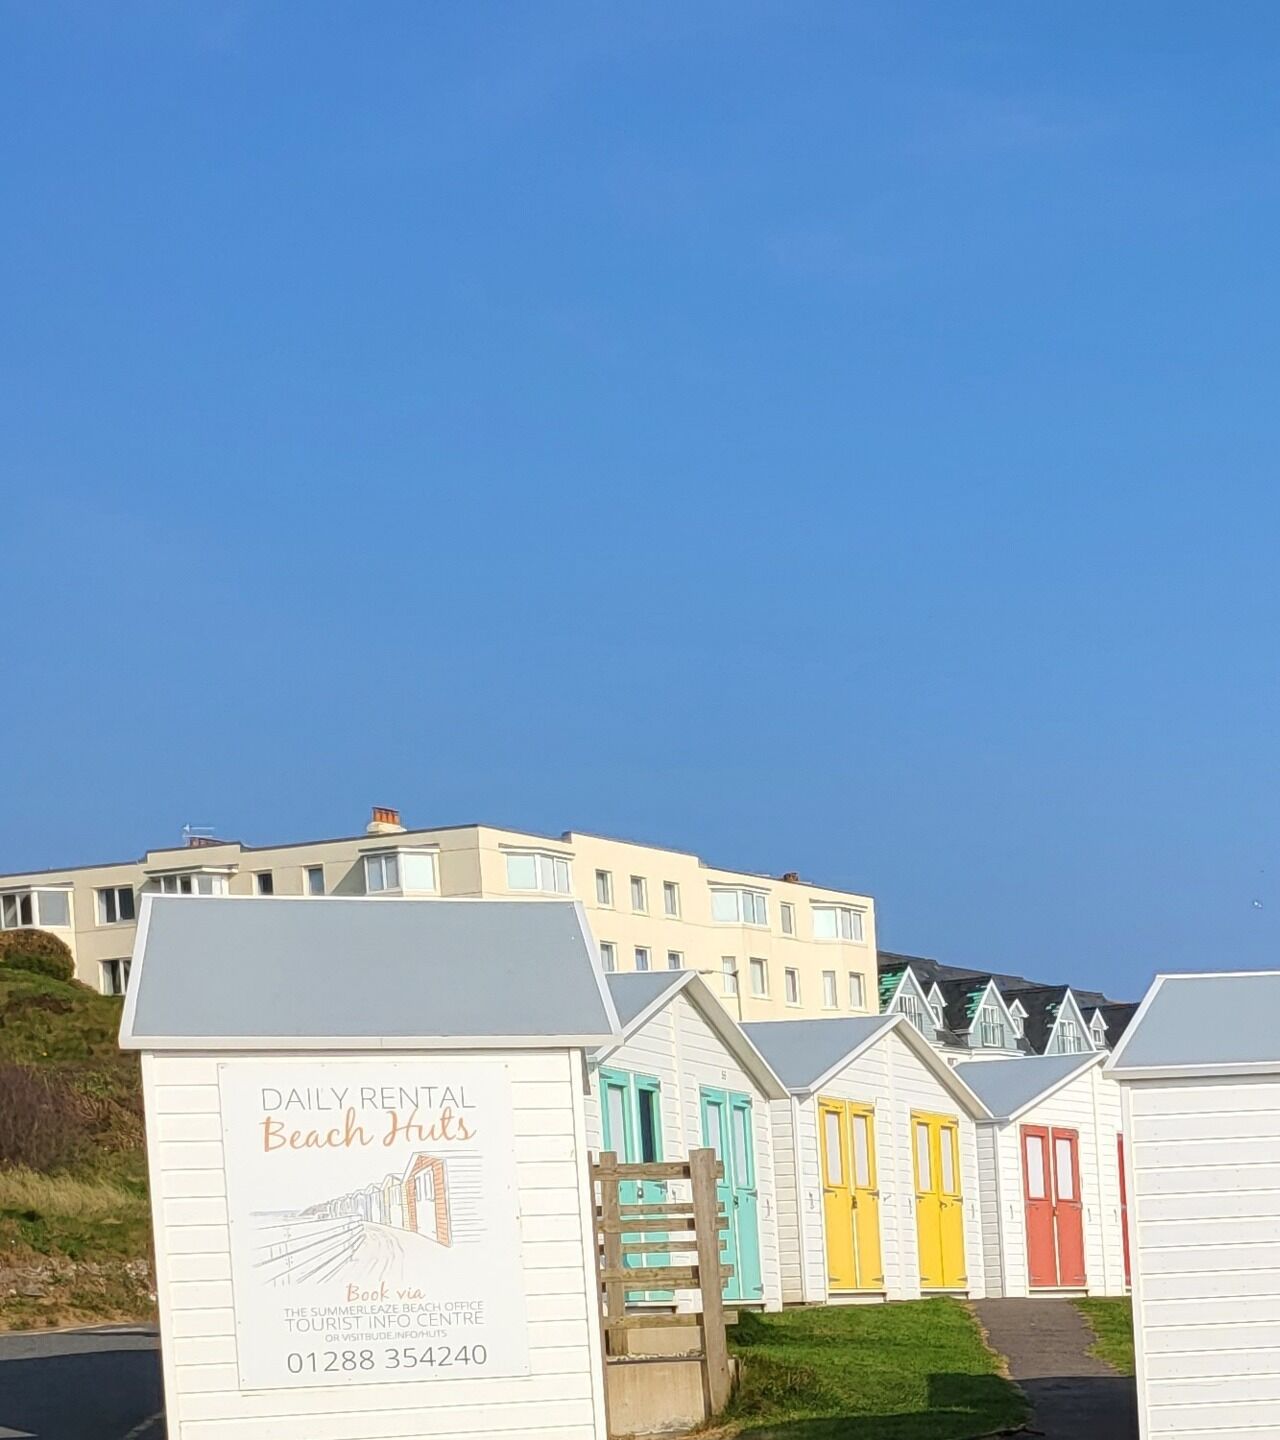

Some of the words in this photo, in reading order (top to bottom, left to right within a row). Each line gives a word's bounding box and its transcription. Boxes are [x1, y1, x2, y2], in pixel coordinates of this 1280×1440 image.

[261, 1087, 349, 1111] DAILY
[360, 1086, 477, 1110] RENTAL
[259, 1106, 374, 1152] Beach
[382, 1106, 477, 1147] Huts
[346, 1281, 390, 1302] Book
[396, 1287, 426, 1300] via
[284, 1307, 307, 1318] THE
[310, 1304, 399, 1317] SUMMERLEAZE
[402, 1302, 441, 1313] BEACH
[444, 1301, 484, 1312] OFFICE
[284, 1316, 363, 1332] TOURIST
[368, 1314, 411, 1329] INFO
[416, 1311, 485, 1327] CENTRE
[325, 1333, 340, 1343] OR
[287, 1349, 375, 1373] 01288
[384, 1344, 488, 1369] 354240
